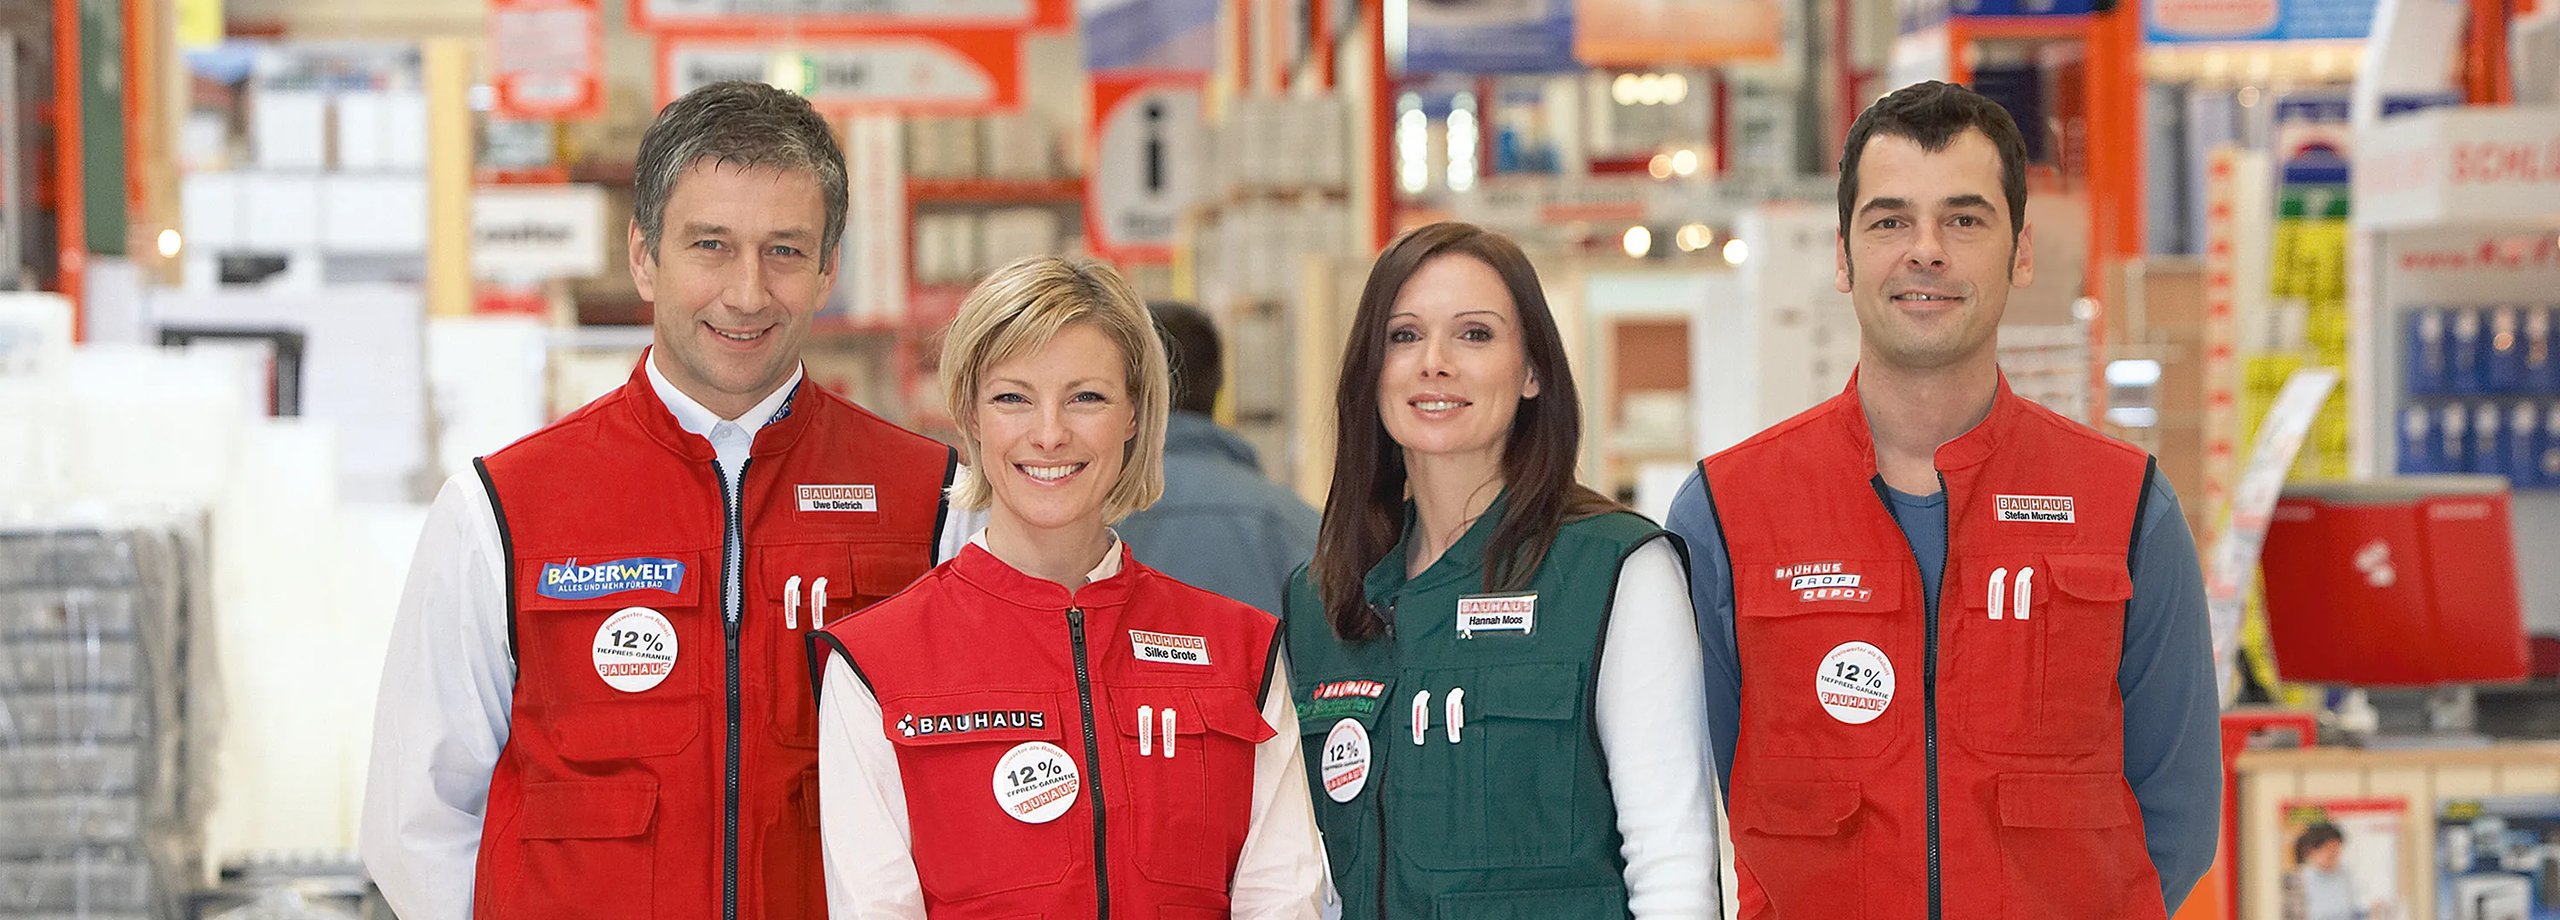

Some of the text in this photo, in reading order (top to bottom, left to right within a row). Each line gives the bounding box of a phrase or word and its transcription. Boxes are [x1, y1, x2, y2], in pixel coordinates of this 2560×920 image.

[801, 487, 874, 500] BAUHAUS
[813, 501, 862, 510] Uwe Dietrich
[1999, 497, 2073, 511] BAUHAUS
[2005, 511, 2068, 521] Stefan Murzwski
[548, 557, 678, 585] BÄDERWELT
[1776, 562, 1842, 579] BAUHAUS
[558, 584, 583, 592] ALLES
[585, 583, 600, 591] UND
[602, 582, 624, 590] MEHR
[1794, 576, 1856, 588] PROFI
[1803, 589, 1870, 600] DEPOT
[1460, 601, 1532, 614] BAUHAUS
[1469, 615, 1523, 626] Hannah Moos
[1132, 631, 1203, 649] BAUHAUS
[1144, 646, 1197, 661] Silke Grote
[600, 662, 671, 677] BAUHAUS
[1820, 674, 1890, 699] TIEFPREIS-GARANTIE
[1821, 691, 1888, 712] BAUHAUS
[919, 710, 1045, 735] BAUHAUS
